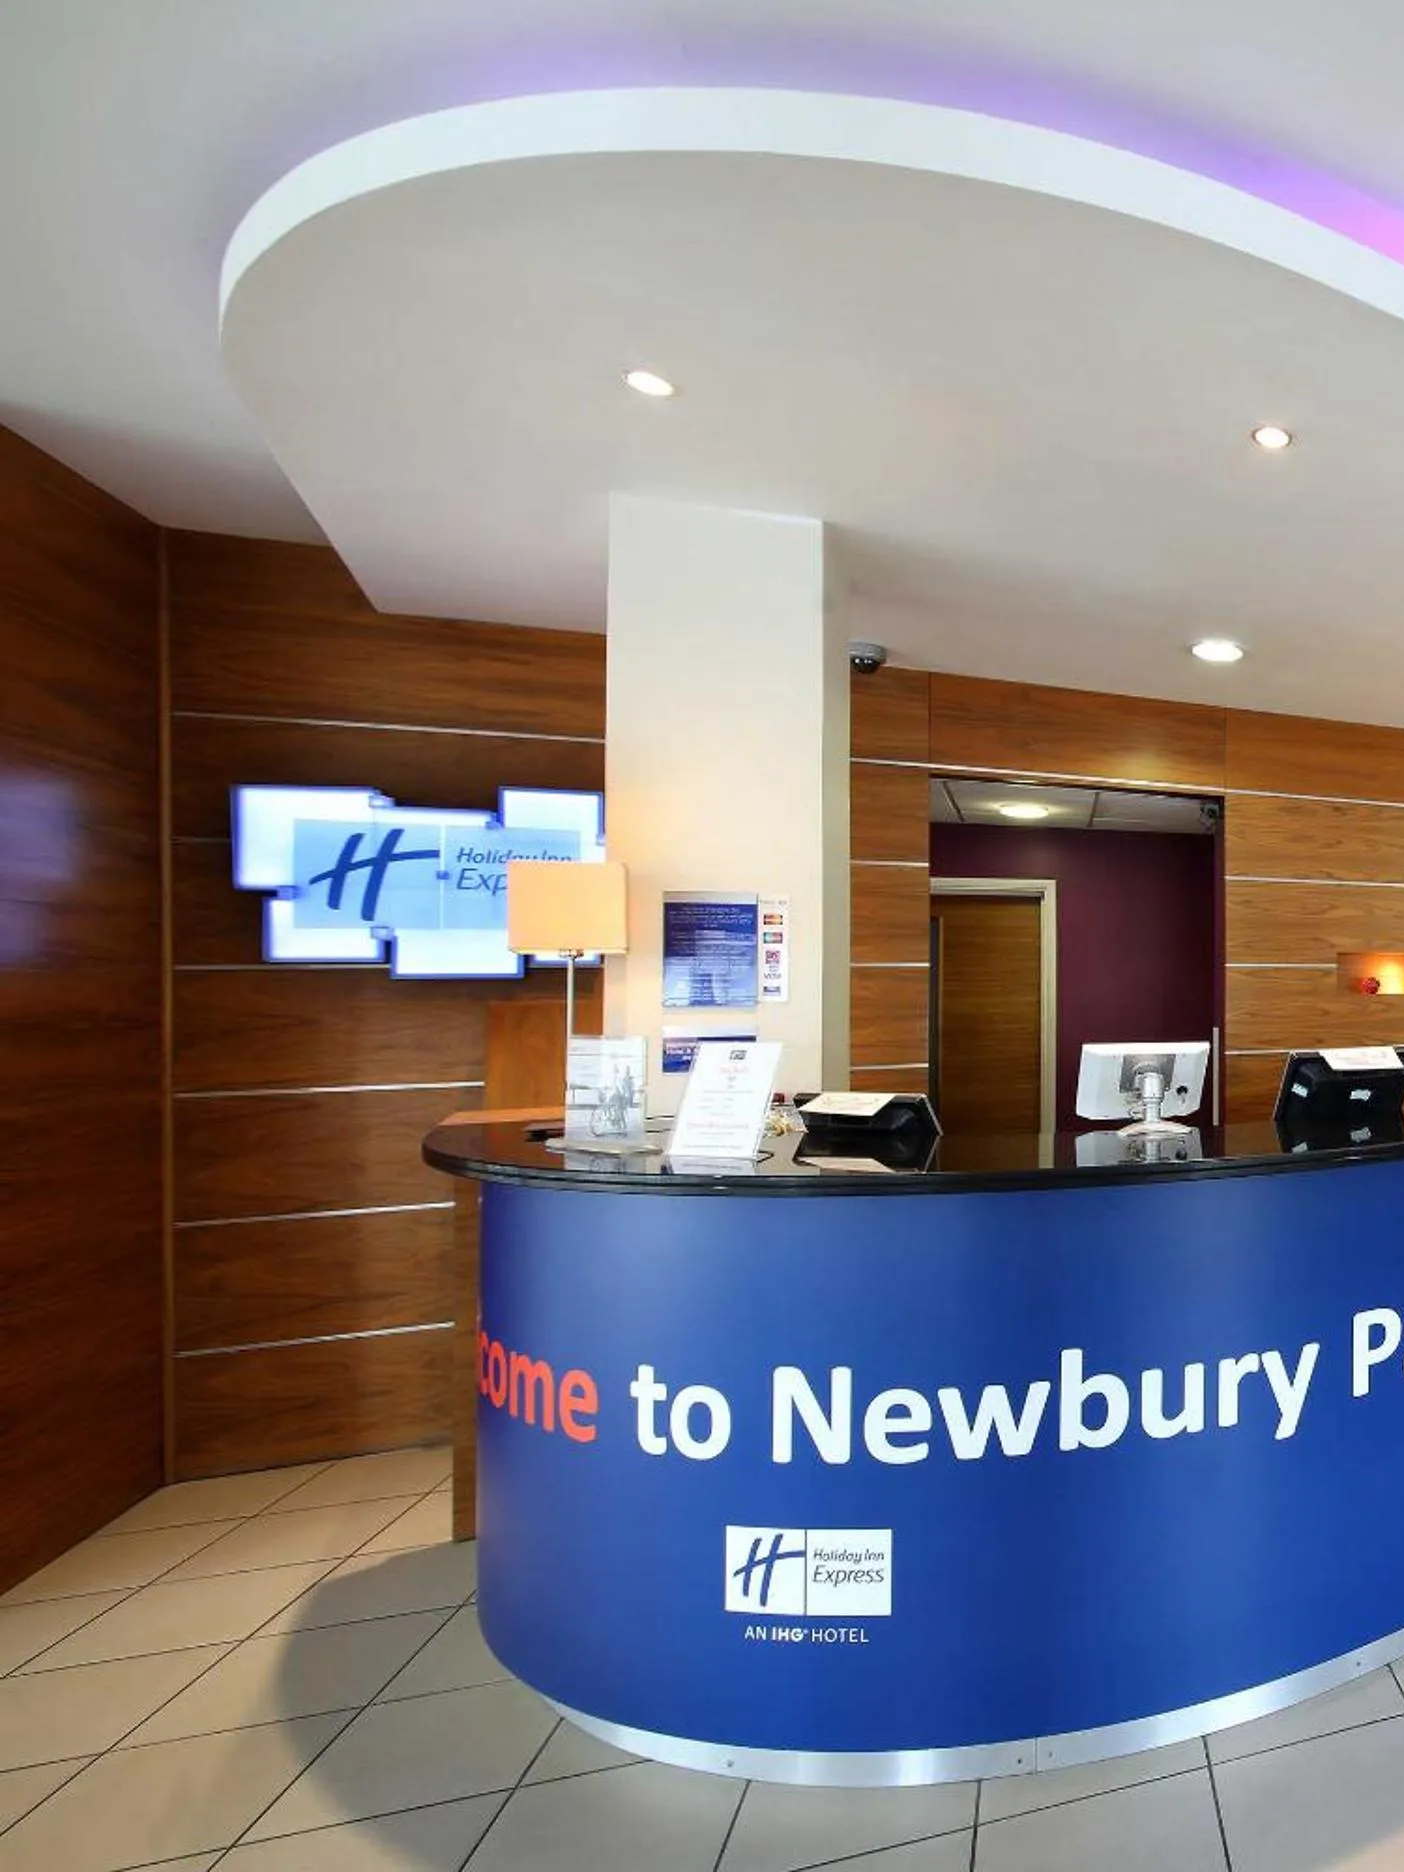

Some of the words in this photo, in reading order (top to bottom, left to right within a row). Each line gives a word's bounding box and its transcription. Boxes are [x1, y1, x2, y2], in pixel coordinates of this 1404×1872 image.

[629, 1364, 731, 1461] to
[772, 1342, 1320, 1465] Newbury
[813, 1548, 862, 1564] Holiday
[864, 1548, 885, 1561] Inn
[812, 1564, 885, 1587] Express
[744, 1626, 767, 1641] AN
[811, 1628, 869, 1643] HOTEL
